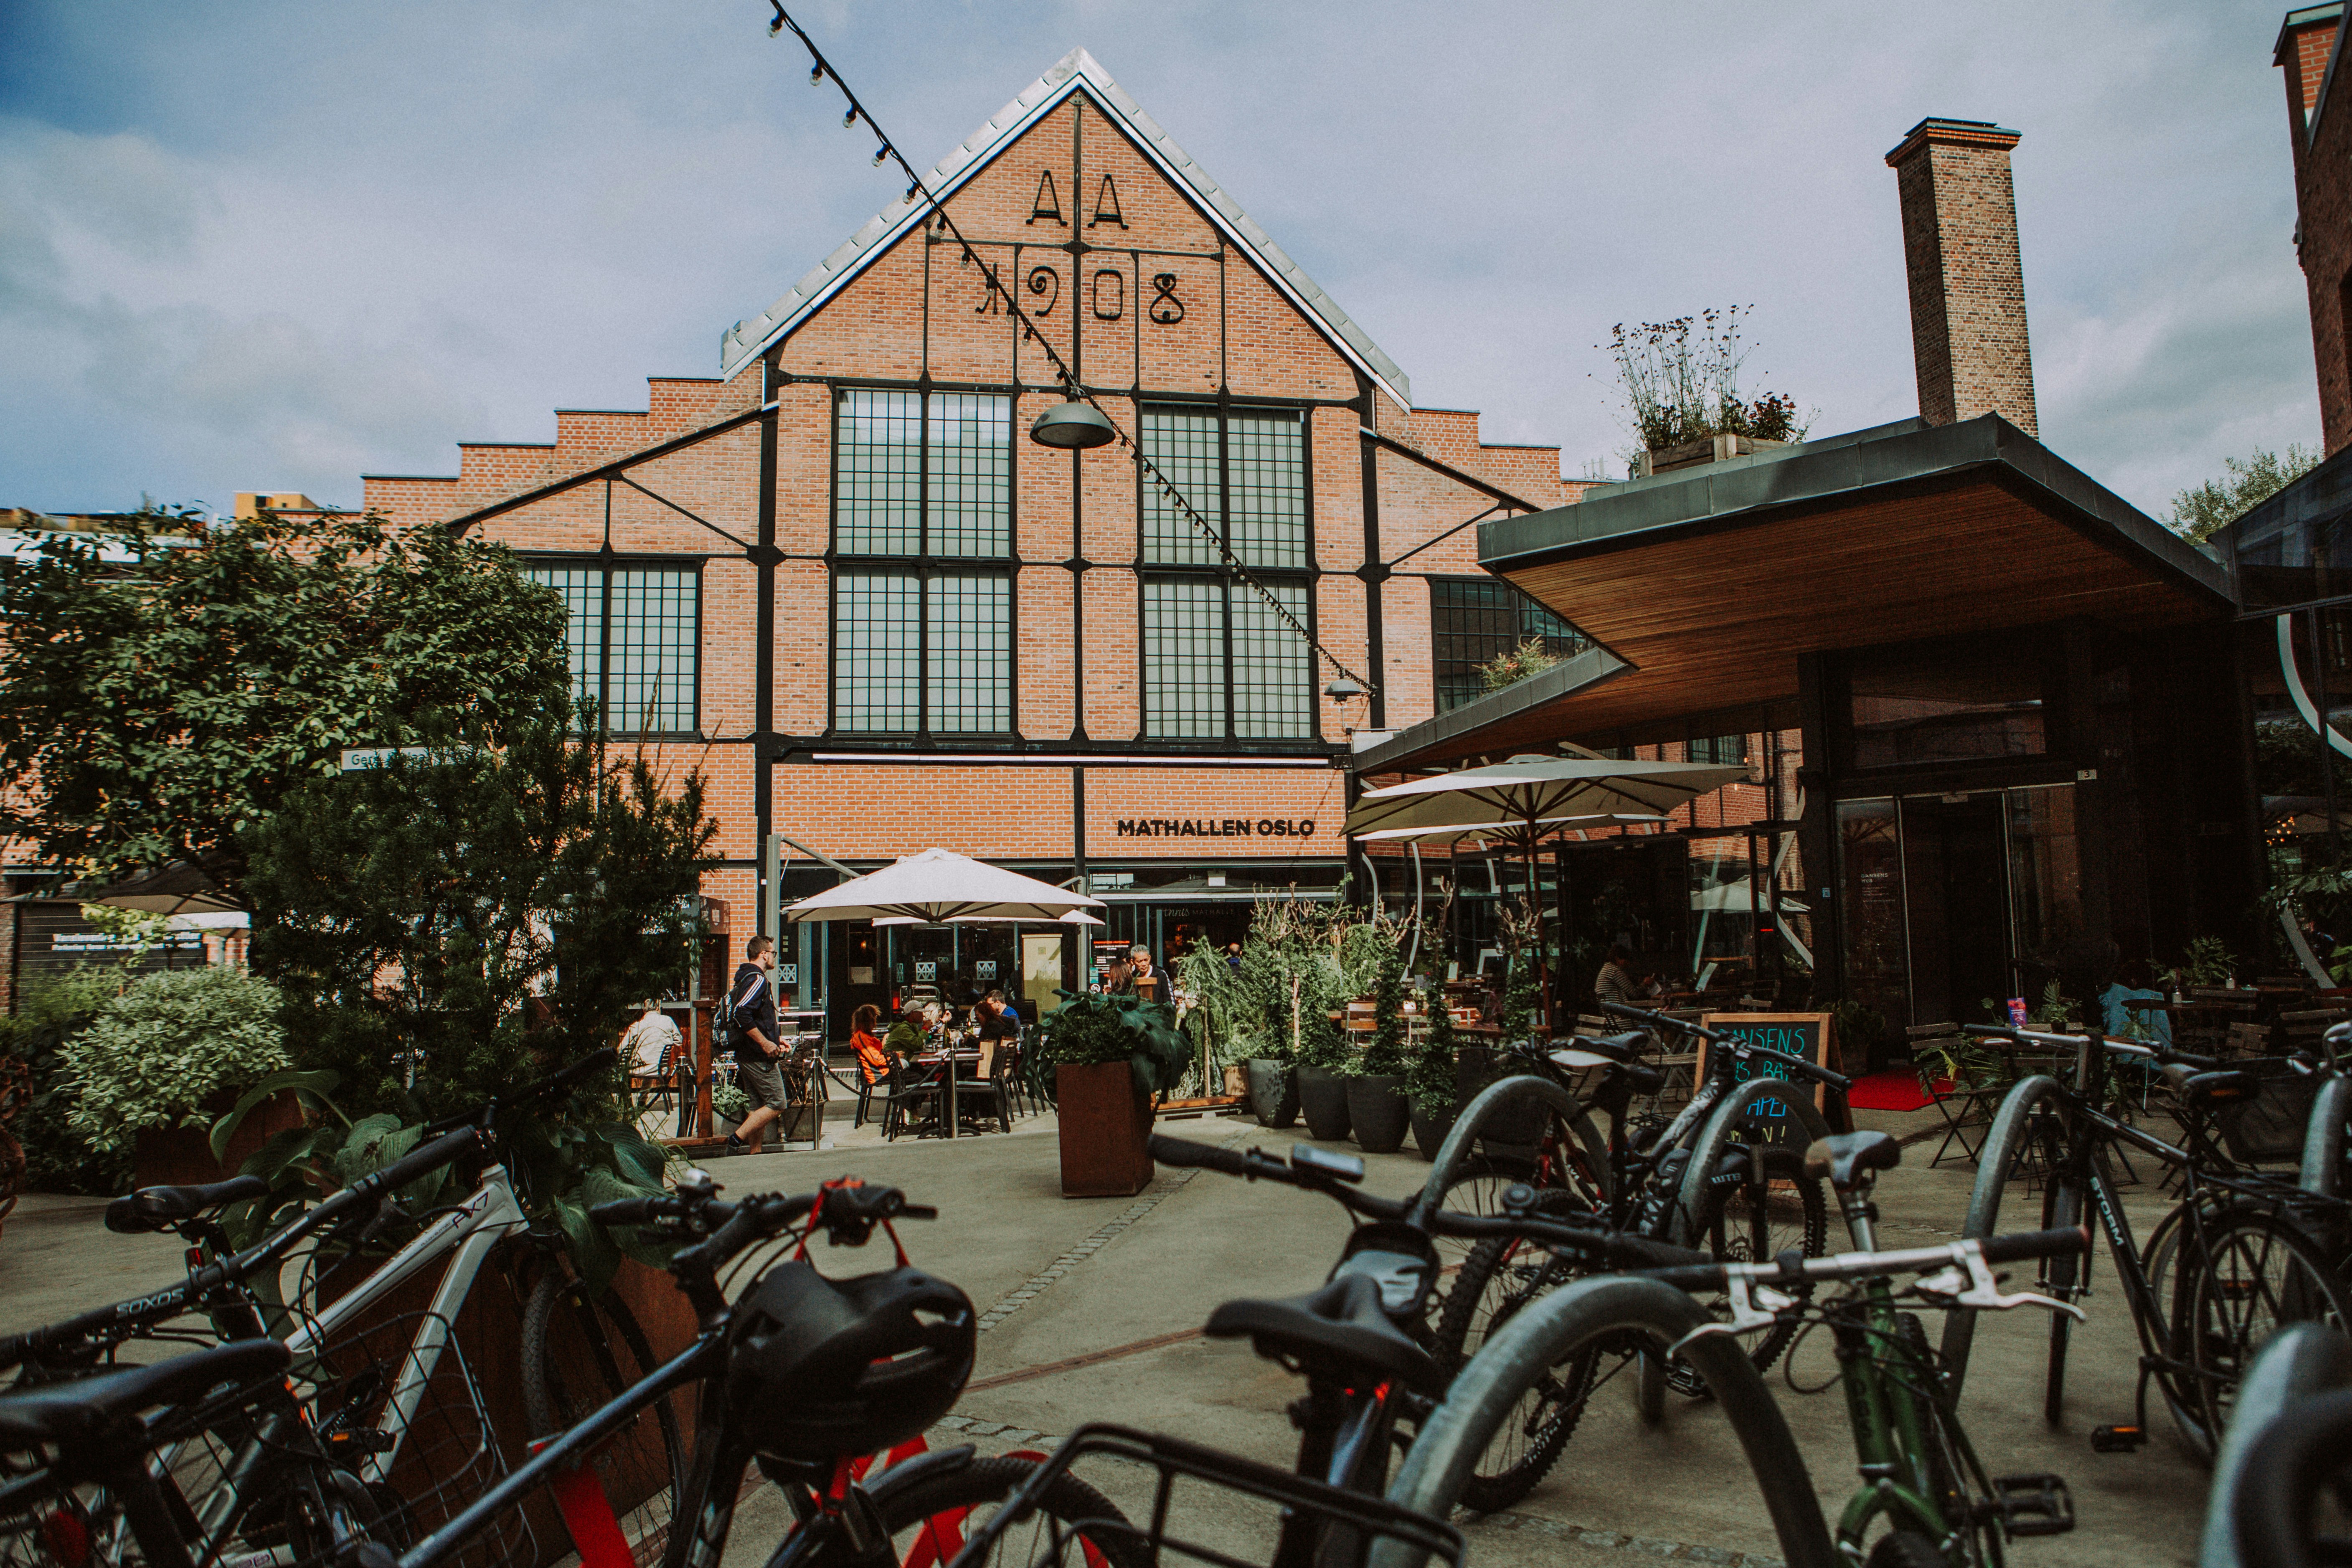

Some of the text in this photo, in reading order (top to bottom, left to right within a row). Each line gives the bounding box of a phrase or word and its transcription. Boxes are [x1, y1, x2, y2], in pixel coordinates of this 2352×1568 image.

[1118, 819, 1315, 836] MATHALLEN OSLO
[1711, 1173, 1741, 1183] WTB
[452, 1191, 489, 1229] FX7
[2090, 1176, 2124, 1246] STORM
